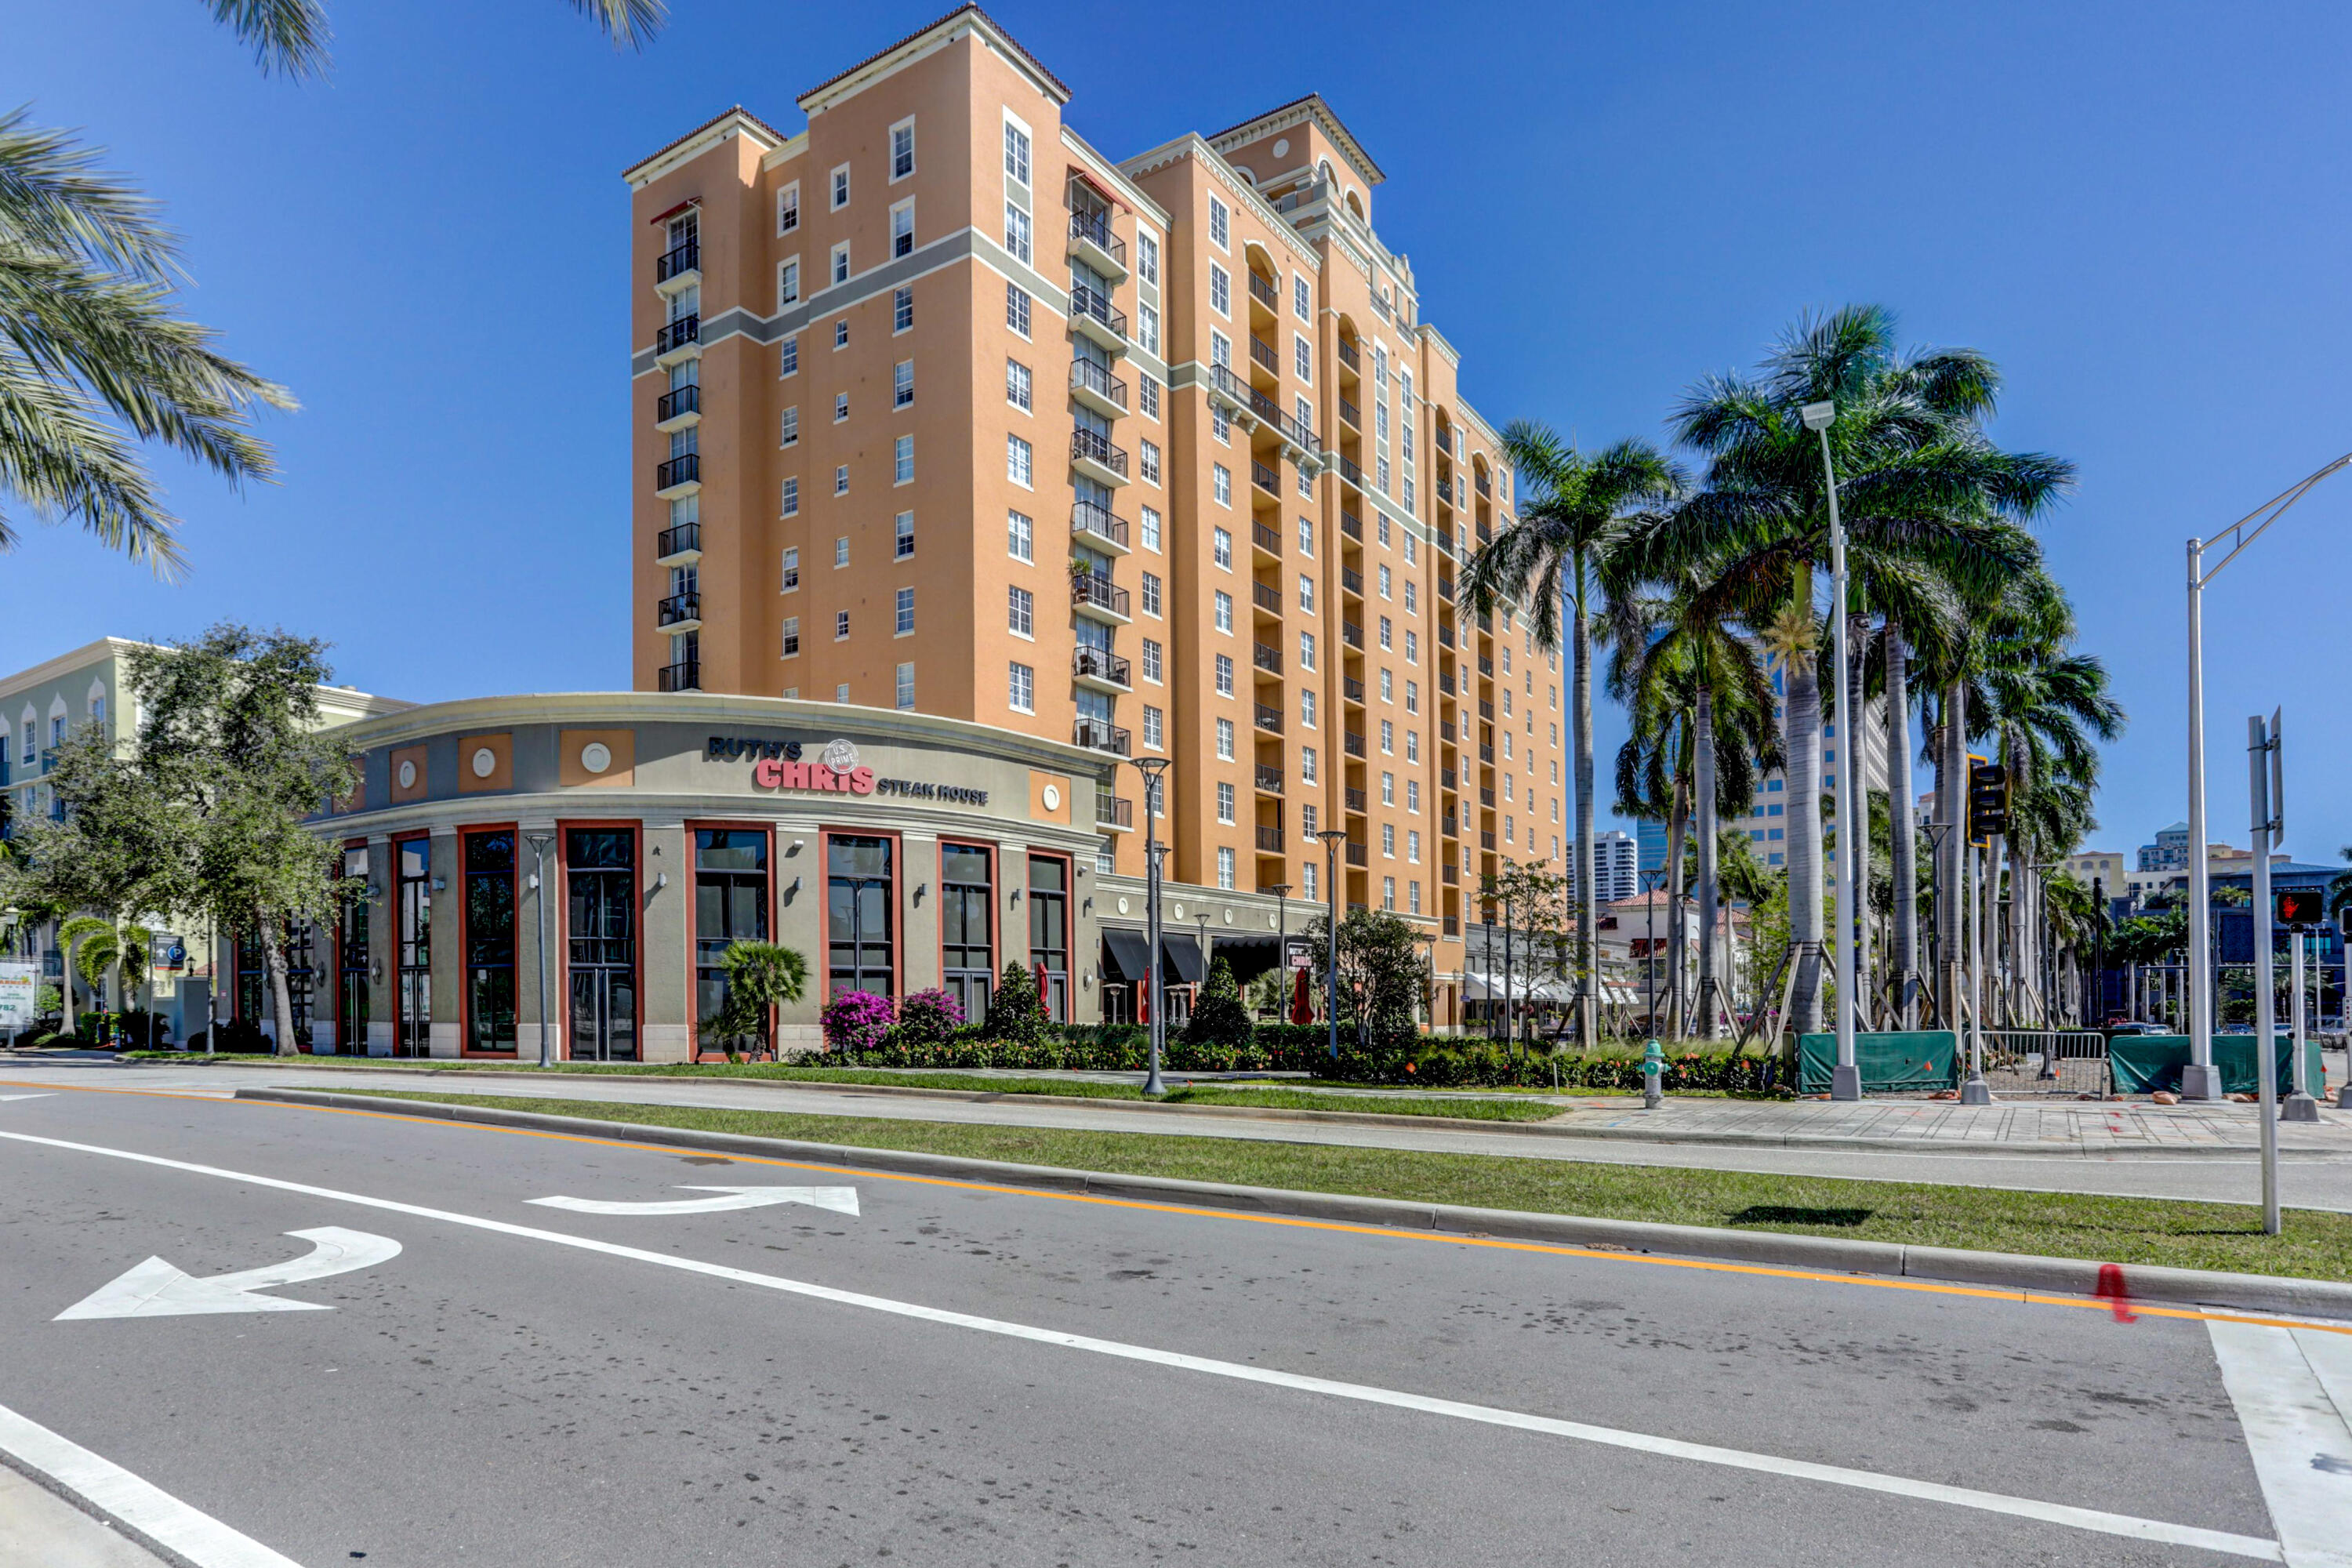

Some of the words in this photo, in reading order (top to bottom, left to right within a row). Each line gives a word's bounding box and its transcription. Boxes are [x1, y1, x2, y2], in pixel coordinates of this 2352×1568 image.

[708, 737, 803, 759] RUTH'S
[833, 745, 848, 755] U.S.
[831, 753, 855, 765] PRIME
[757, 759, 875, 793] CHRIS
[878, 778, 935, 796] STEAK
[938, 785, 988, 804] HOUSE
[173, 948, 183, 957] P
